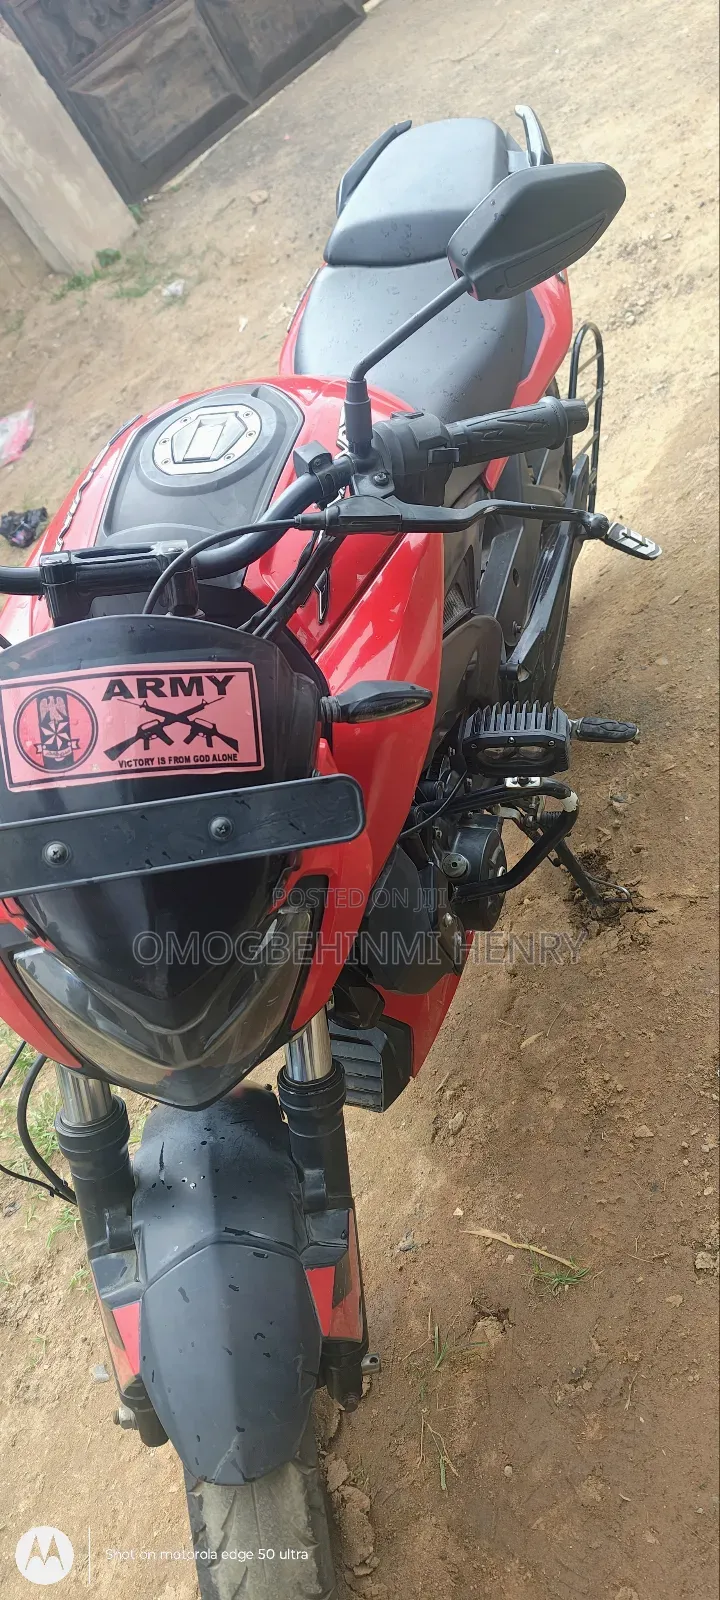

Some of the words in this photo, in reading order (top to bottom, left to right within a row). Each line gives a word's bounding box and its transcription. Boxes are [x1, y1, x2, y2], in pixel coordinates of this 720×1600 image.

[102, 674, 235, 701] ARMY
[118, 757, 155, 769] VICTORY
[157, 755, 166, 766] IS
[168, 754, 191, 765] FROM
[193, 753, 211, 764] GOD
[212, 753, 238, 763] ALONE
